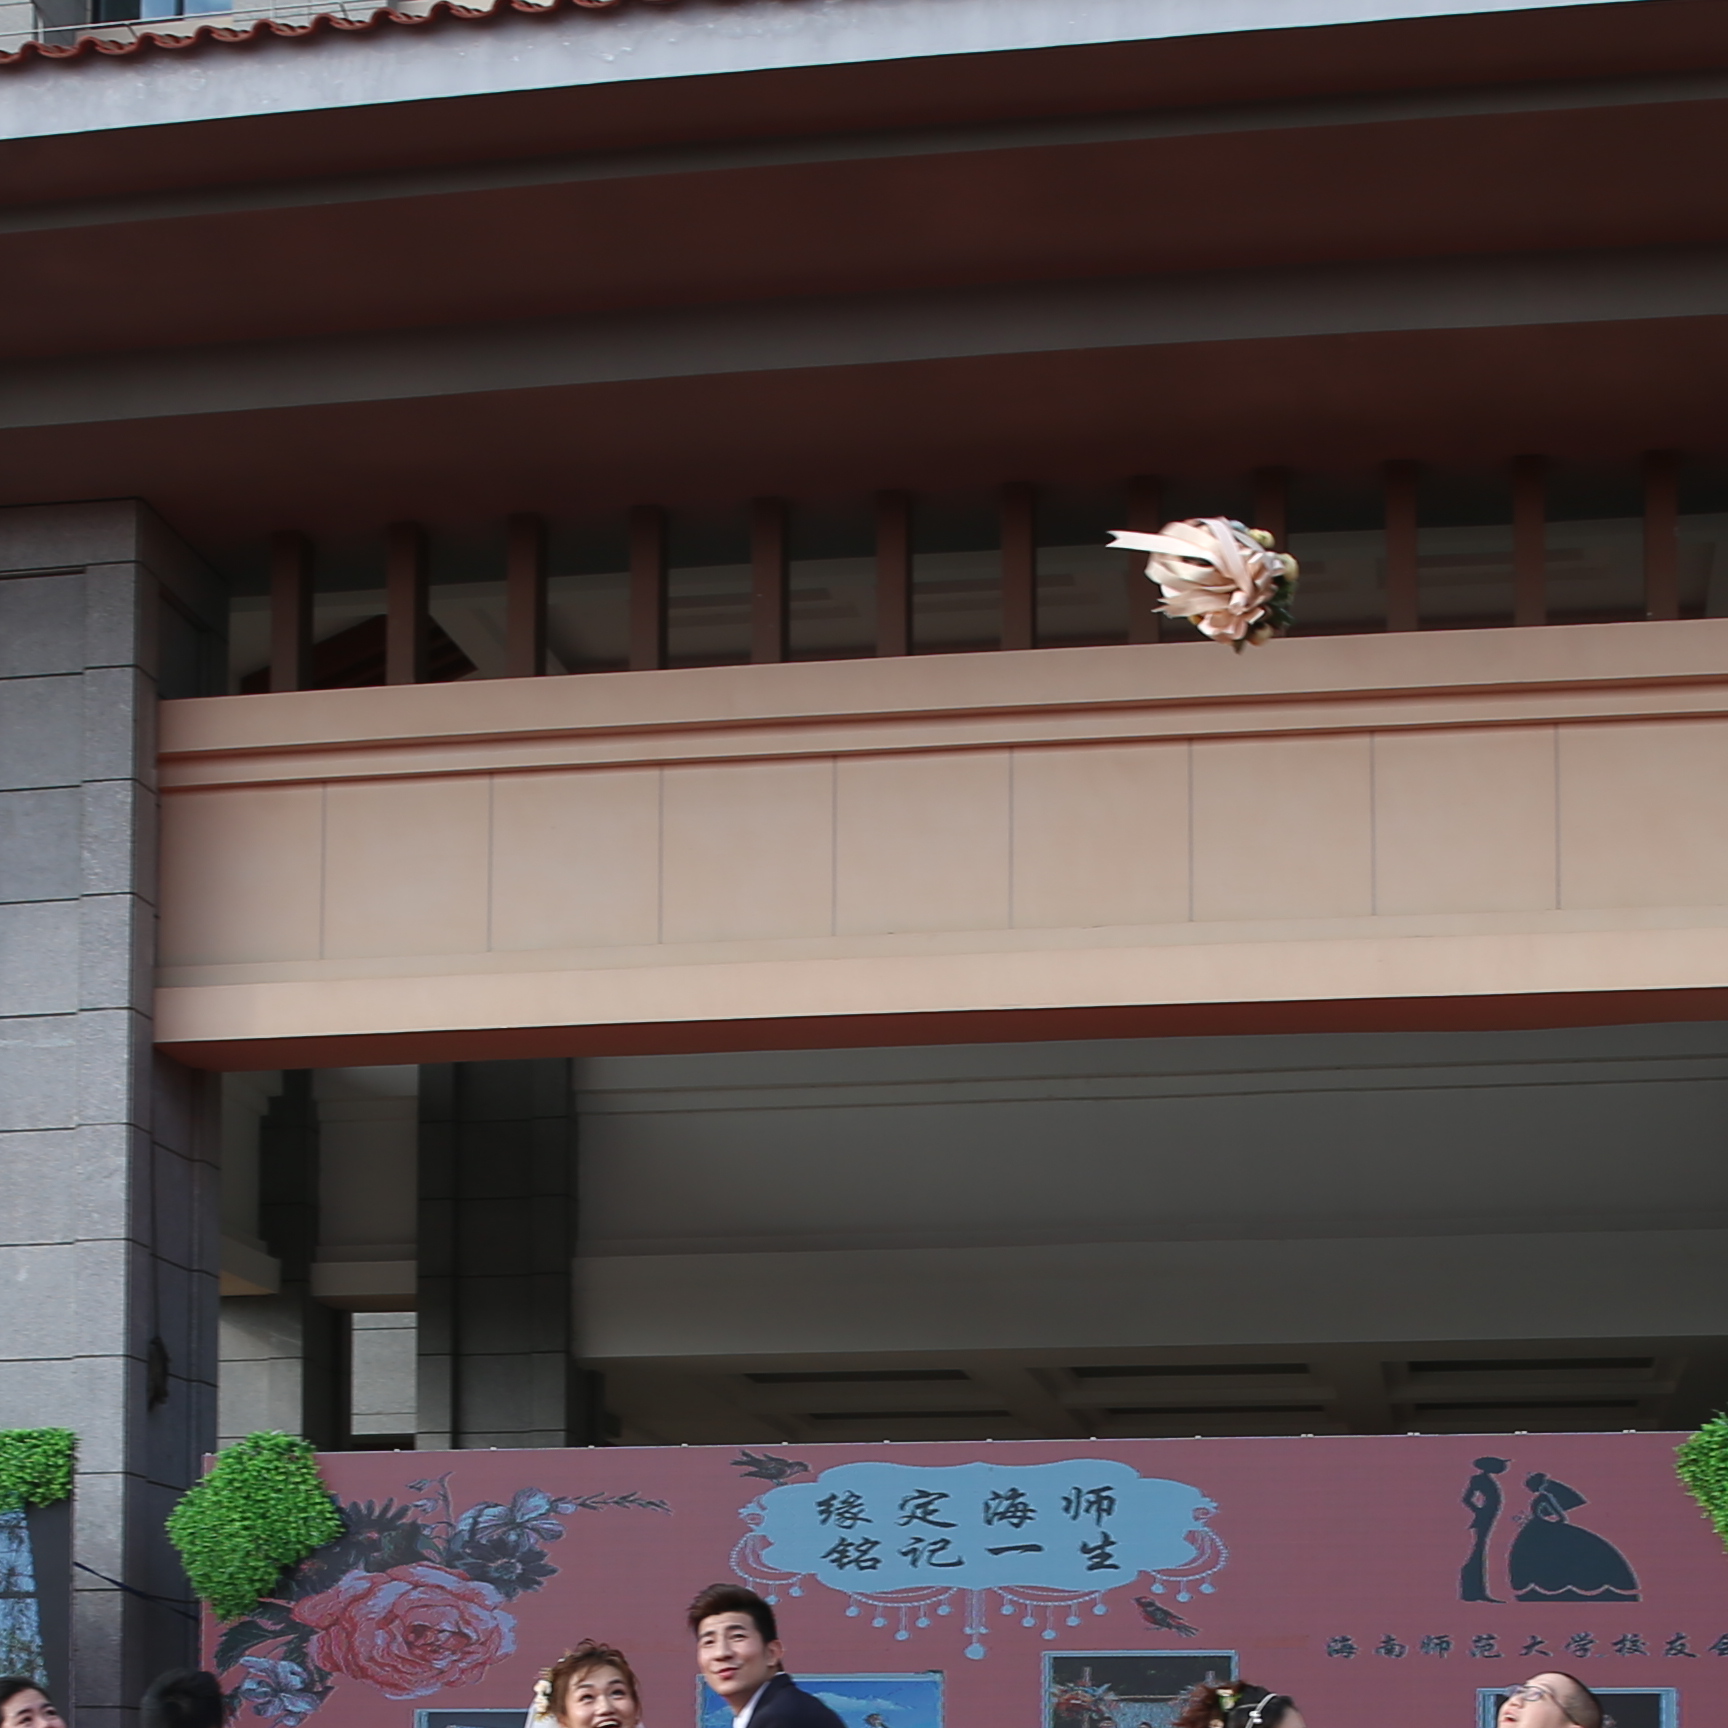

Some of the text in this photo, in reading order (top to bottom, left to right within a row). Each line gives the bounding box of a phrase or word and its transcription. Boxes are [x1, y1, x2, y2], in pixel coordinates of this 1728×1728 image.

[815, 1485, 1118, 1529] 缘定海师
[821, 1530, 1121, 1572] 铭记一生
